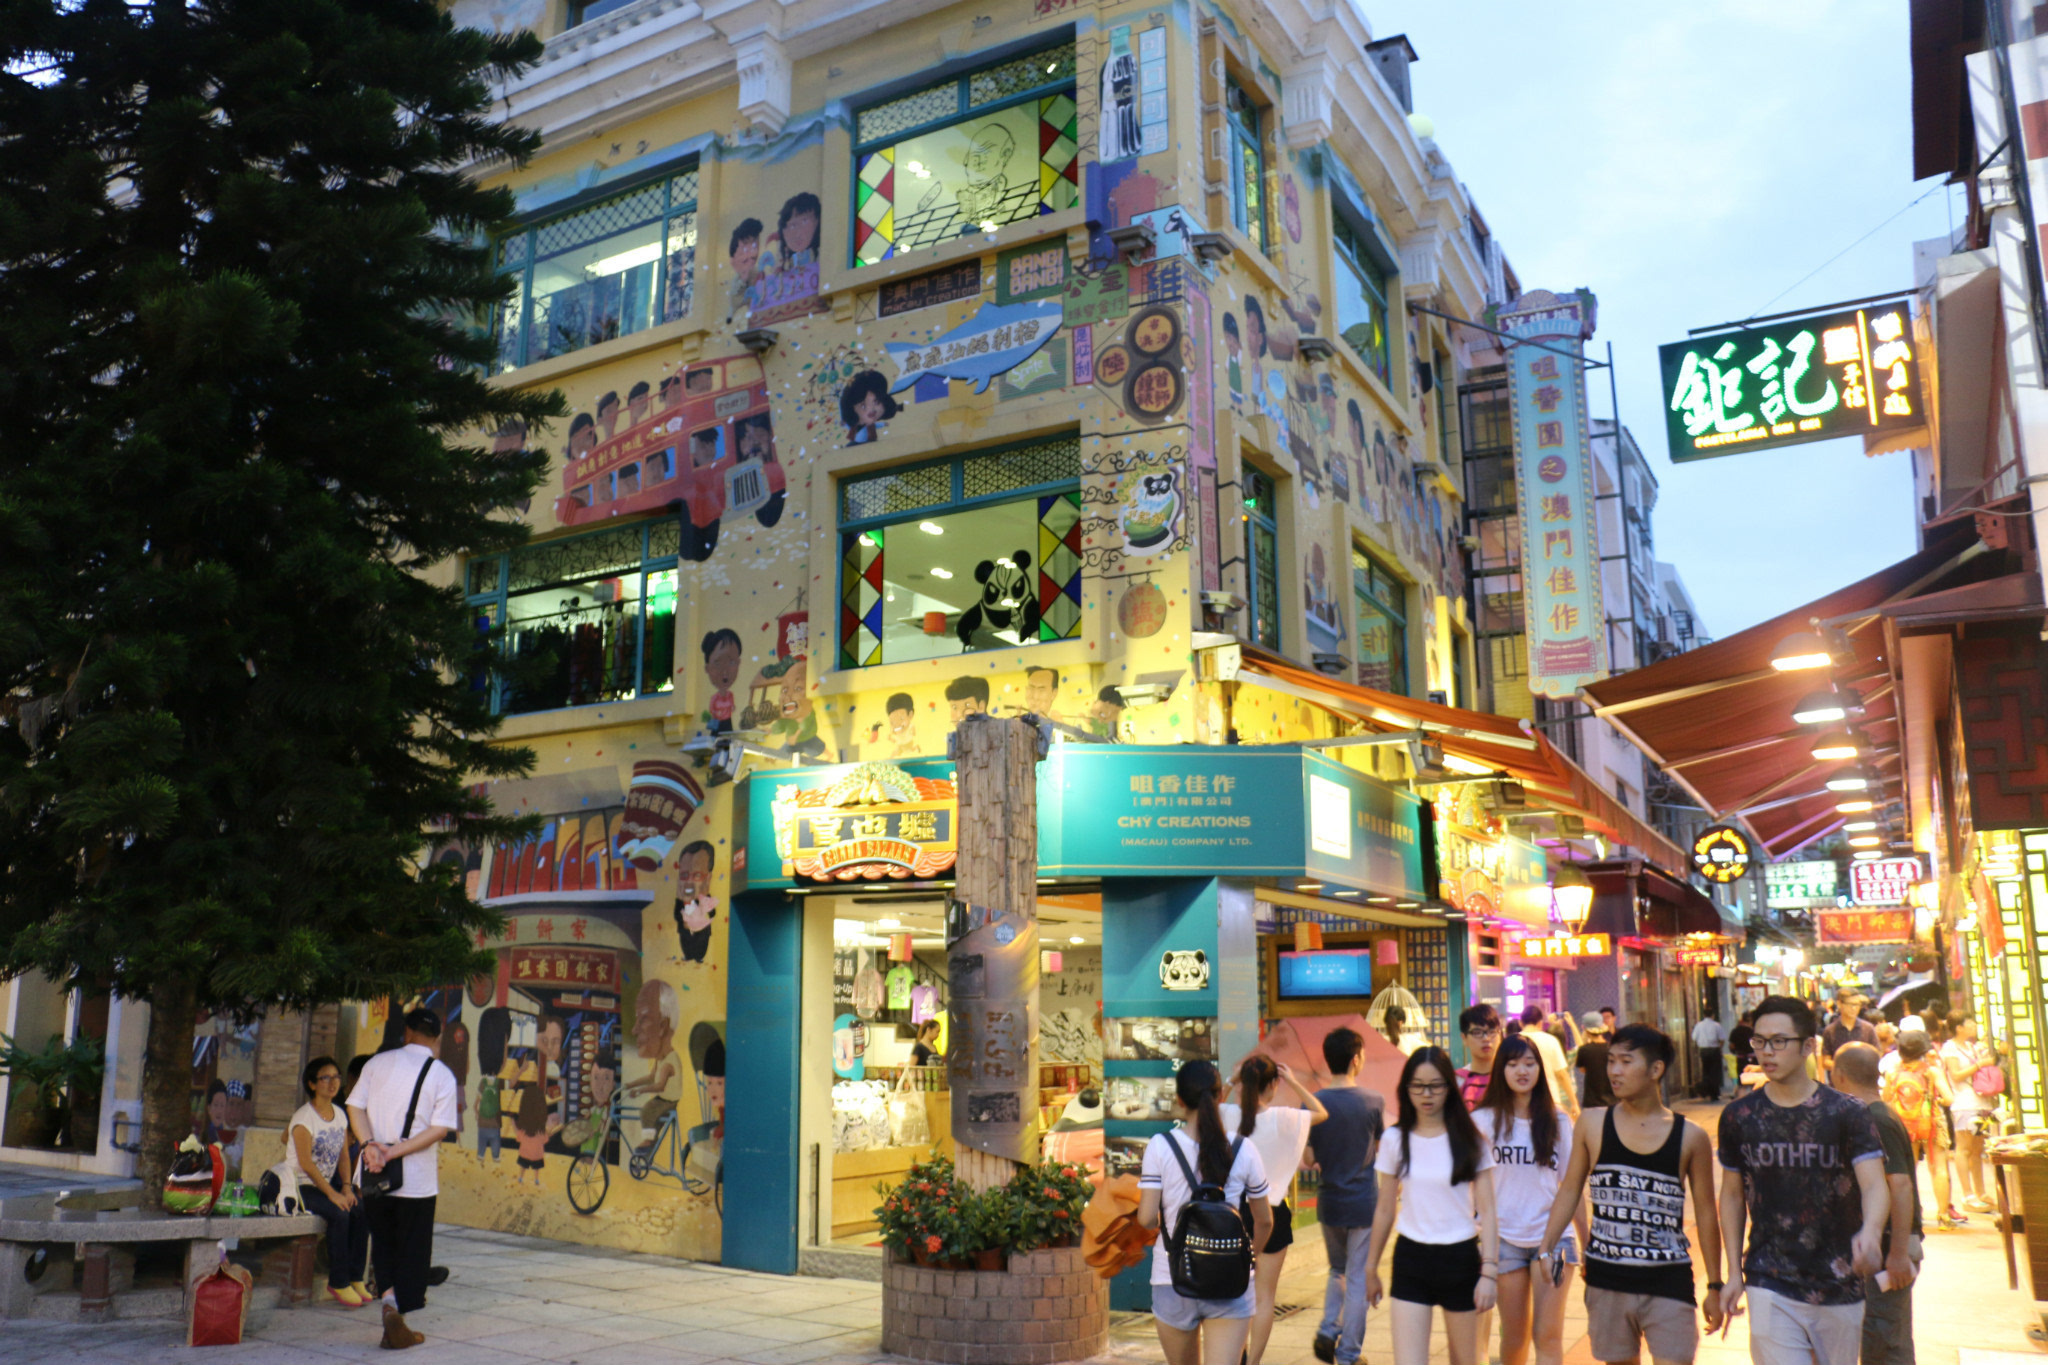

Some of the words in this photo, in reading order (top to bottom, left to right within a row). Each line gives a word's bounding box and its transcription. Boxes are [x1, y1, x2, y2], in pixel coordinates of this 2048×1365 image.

[1011, 248, 1065, 277] BANG!
[1011, 265, 1065, 295] BANG!
[883, 297, 922, 315] macau
[926, 284, 980, 305] creations
[1671, 329, 1840, 437] 鉅記
[1130, 774, 1236, 794] 咀香佳作
[1157, 815, 1252, 828] CREATIONS
[1121, 837, 1168, 846] (MACAU)
[1172, 837, 1225, 846] COMPANY
[1229, 837, 1253, 846] LTD.
[518, 959, 608, 982] 咀香園餅家
[1740, 1142, 1844, 1168] SLOTHFUL
[1618, 1174, 1649, 1191] SAY
[1612, 1190, 1640, 1205] THE
